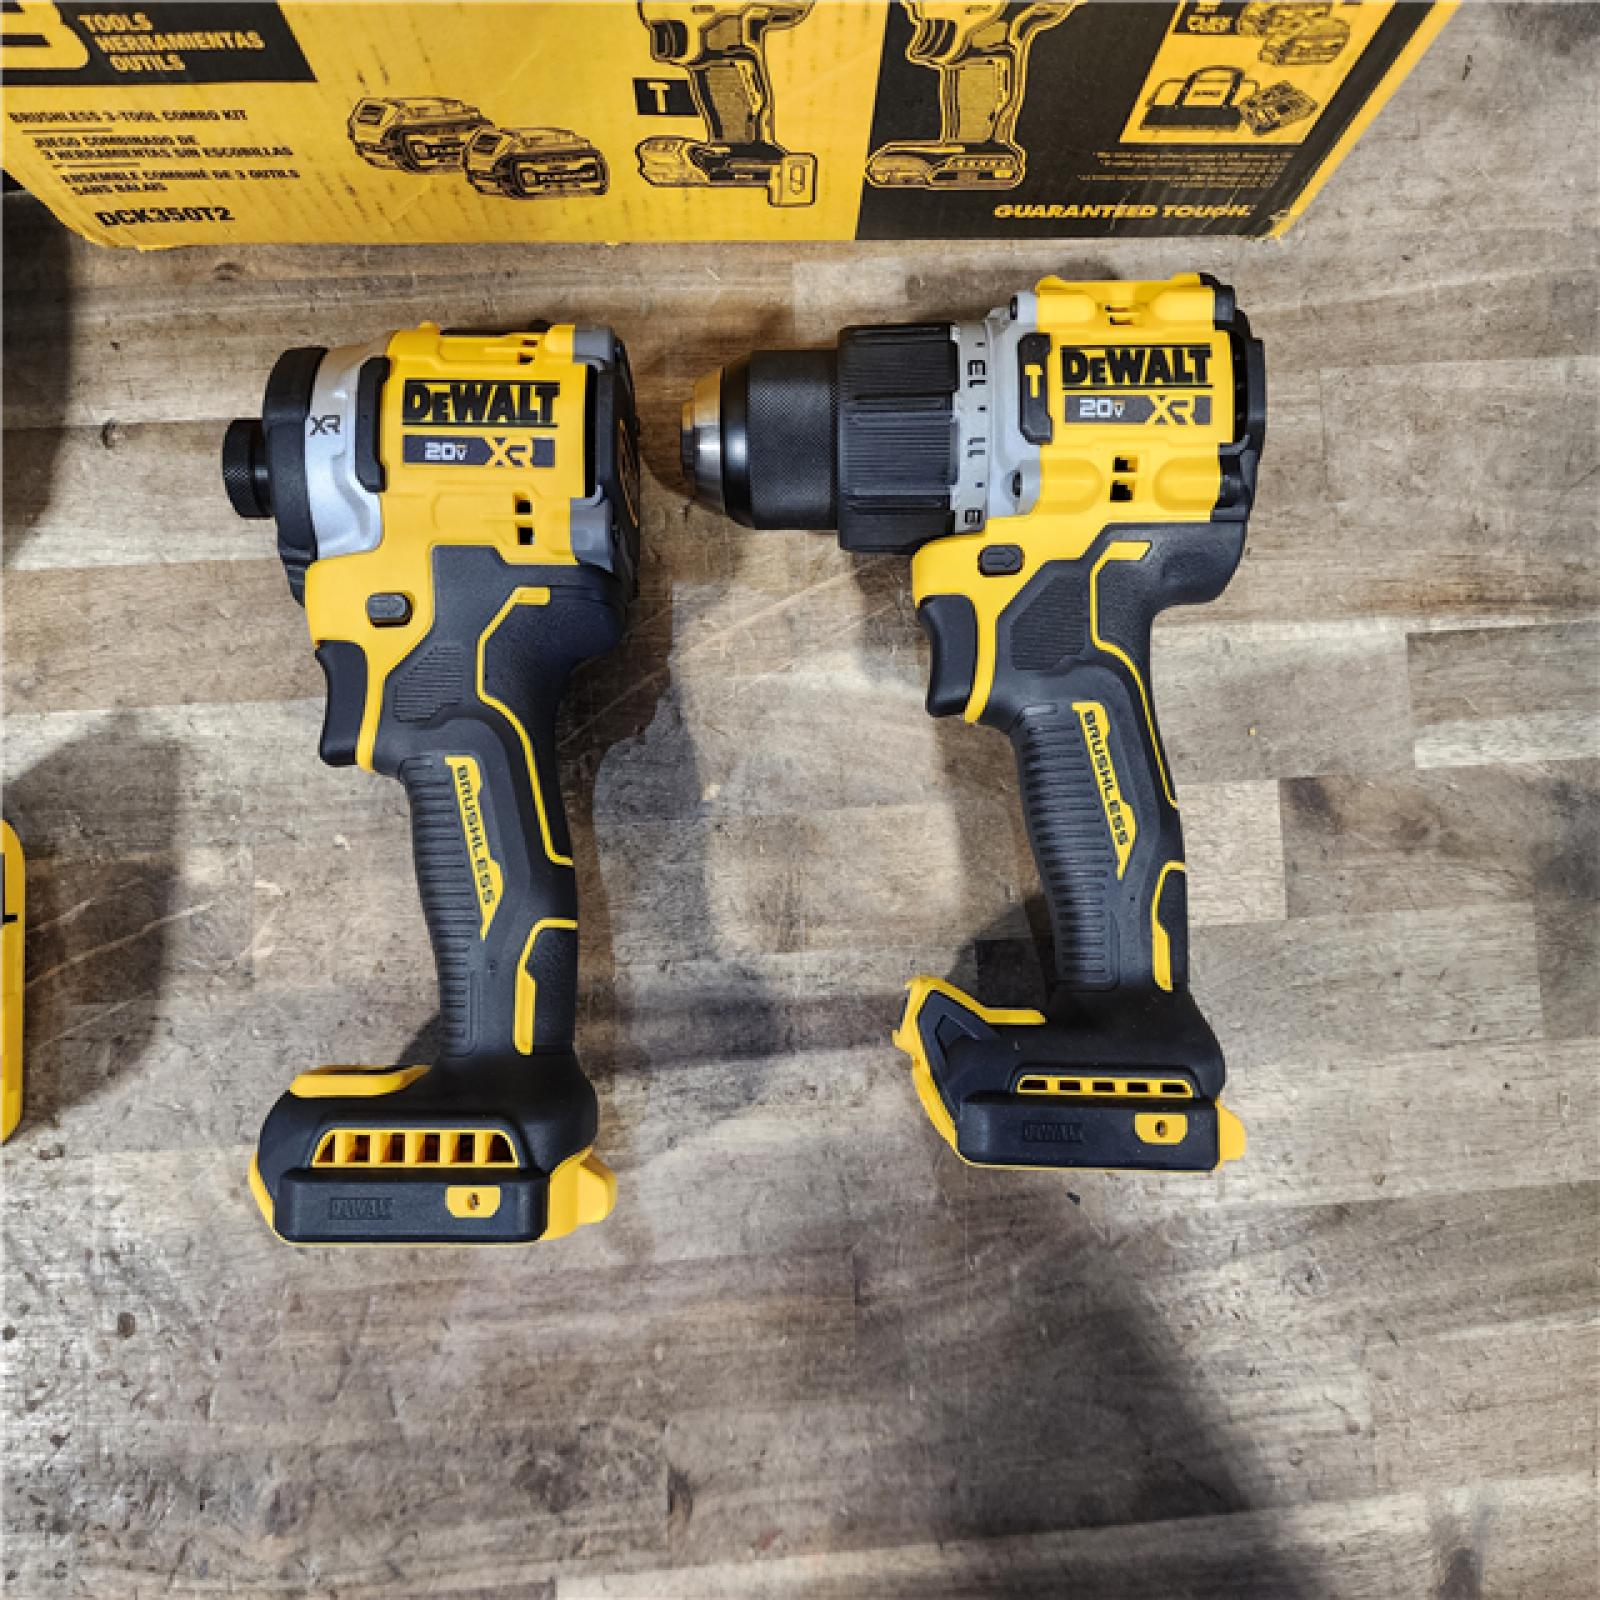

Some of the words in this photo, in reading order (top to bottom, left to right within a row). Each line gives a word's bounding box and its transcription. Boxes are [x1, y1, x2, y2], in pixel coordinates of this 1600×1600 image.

[77, 12, 153, 32] TOOLS
[94, 31, 266, 52] HERRAMIENTAS
[109, 53, 186, 72] OUTILS
[8, 111, 103, 123] BRUSHLESS
[161, 110, 220, 121] COMBO
[220, 109, 248, 120] KIT
[33, 137, 80, 148] JUEGO
[82, 135, 175, 146] COMBINADO
[175, 134, 199, 145] DE
[55, 149, 172, 160] HERRAMIENTAS
[173, 148, 200, 158] SIN
[61, 172, 142, 184] ENSEMBLE
[211, 170, 233, 180] DE
[95, 206, 236, 226] DCK350T2
[1145, 395, 1196, 425] XR
[309, 414, 341, 436] XR
[486, 436, 533, 467] XR
[1084, 710, 1128, 845] BRUSHLESS
[456, 764, 496, 906] BRUSHLESS
